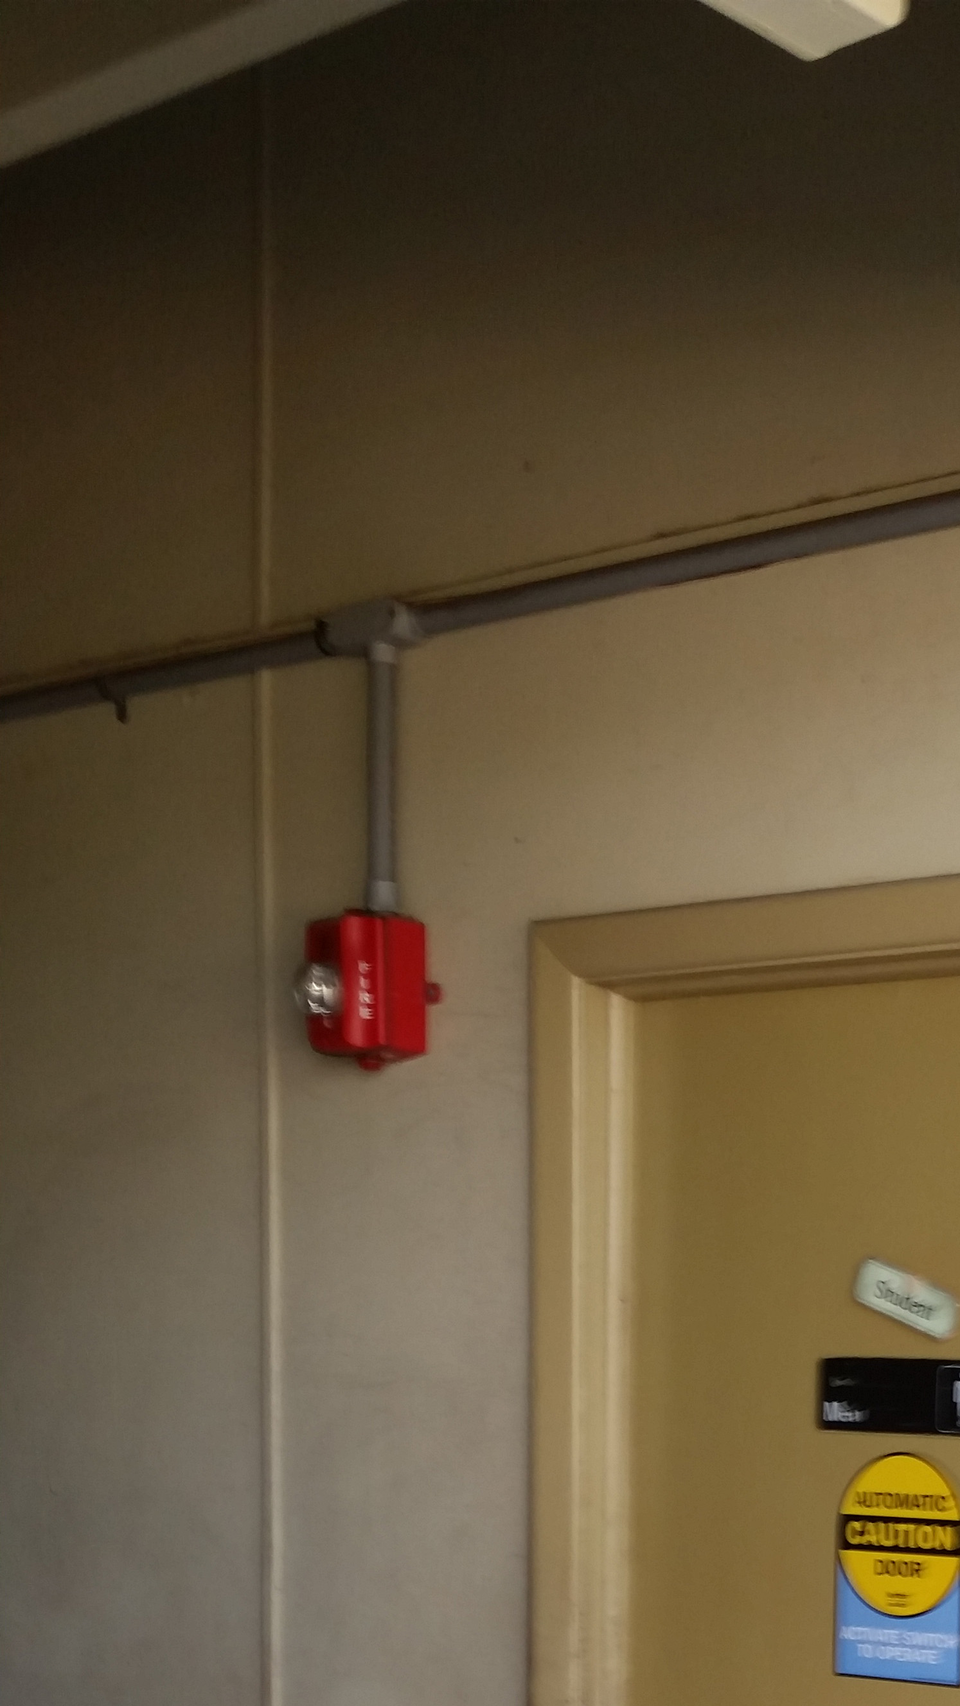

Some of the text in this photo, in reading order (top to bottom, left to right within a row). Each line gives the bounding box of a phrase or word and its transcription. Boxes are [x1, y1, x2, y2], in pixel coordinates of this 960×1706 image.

[854, 1491, 952, 1512] AUTOMATIC
[845, 1520, 958, 1551] CAUTION
[873, 1558, 923, 1578] DOOR
[856, 1643, 873, 1659] TO
